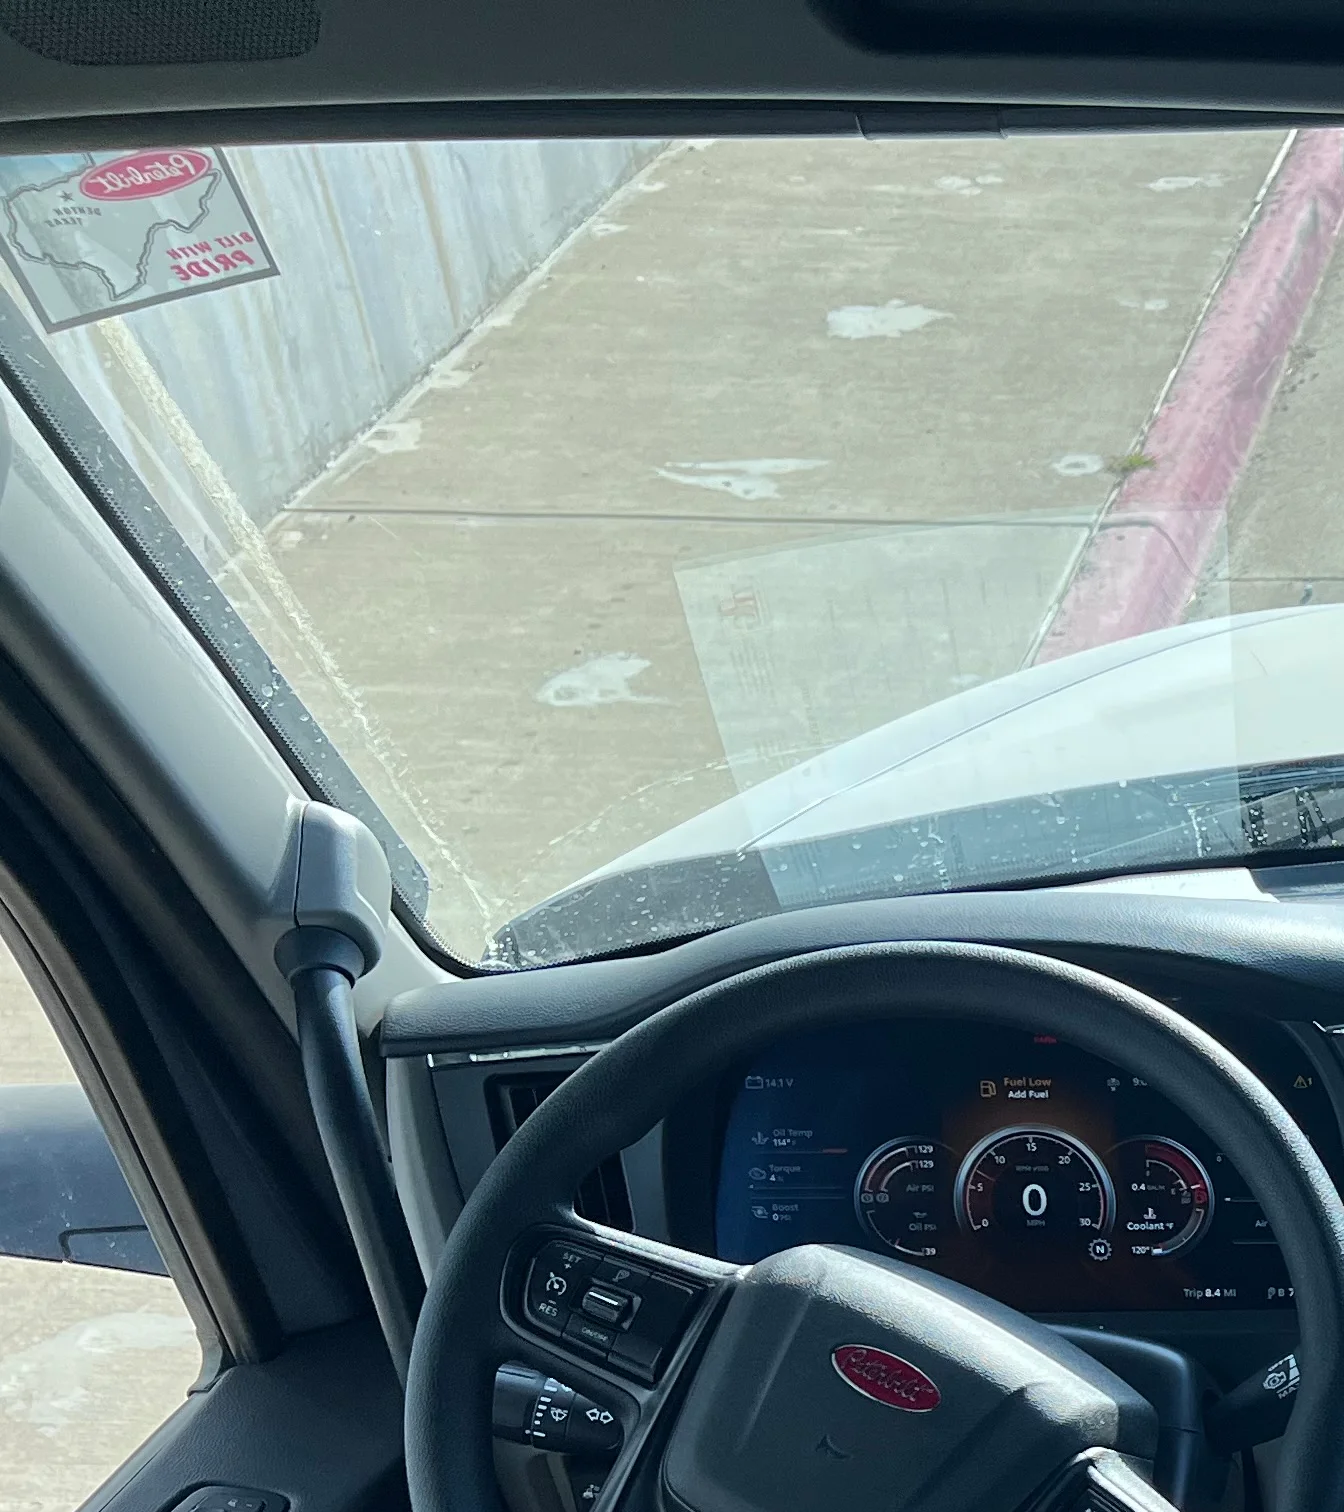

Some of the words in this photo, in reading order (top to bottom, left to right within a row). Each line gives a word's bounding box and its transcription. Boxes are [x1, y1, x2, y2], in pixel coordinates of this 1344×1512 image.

[1004, 1076, 1026, 1087] Fuel
[1028, 1077, 1052, 1087] Low
[1008, 1089, 1026, 1099] Add
[1028, 1089, 1049, 1099] Fuel
[772, 1128, 785, 1137] Oil
[787, 1128, 813, 1139] Temp
[918, 1145, 934, 1153] 129
[1025, 1143, 1037, 1152] 15
[919, 1160, 934, 1169] 129
[994, 1155, 1005, 1165] 10
[1058, 1155, 1071, 1165] 20
[769, 1164, 801, 1175] Torque
[906, 1184, 920, 1192] Air
[976, 1183, 983, 1192] 5
[1079, 1182, 1091, 1191] 25
[1131, 1183, 1146, 1191] 0.4
[1022, 1183, 1048, 1216] 0
[772, 1203, 799, 1211] Boost
[908, 1222, 922, 1231] Oil
[981, 1218, 989, 1227] 0
[1026, 1219, 1045, 1227] MPH
[1079, 1218, 1091, 1227] 30
[1126, 1221, 1164, 1230] Coolant
[924, 1247, 936, 1255] 39
[1183, 1288, 1203, 1299] Trip
[1204, 1288, 1221, 1297] 8.4
[1223, 1288, 1237, 1297] MI
[539, 1302, 558, 1317] RES
